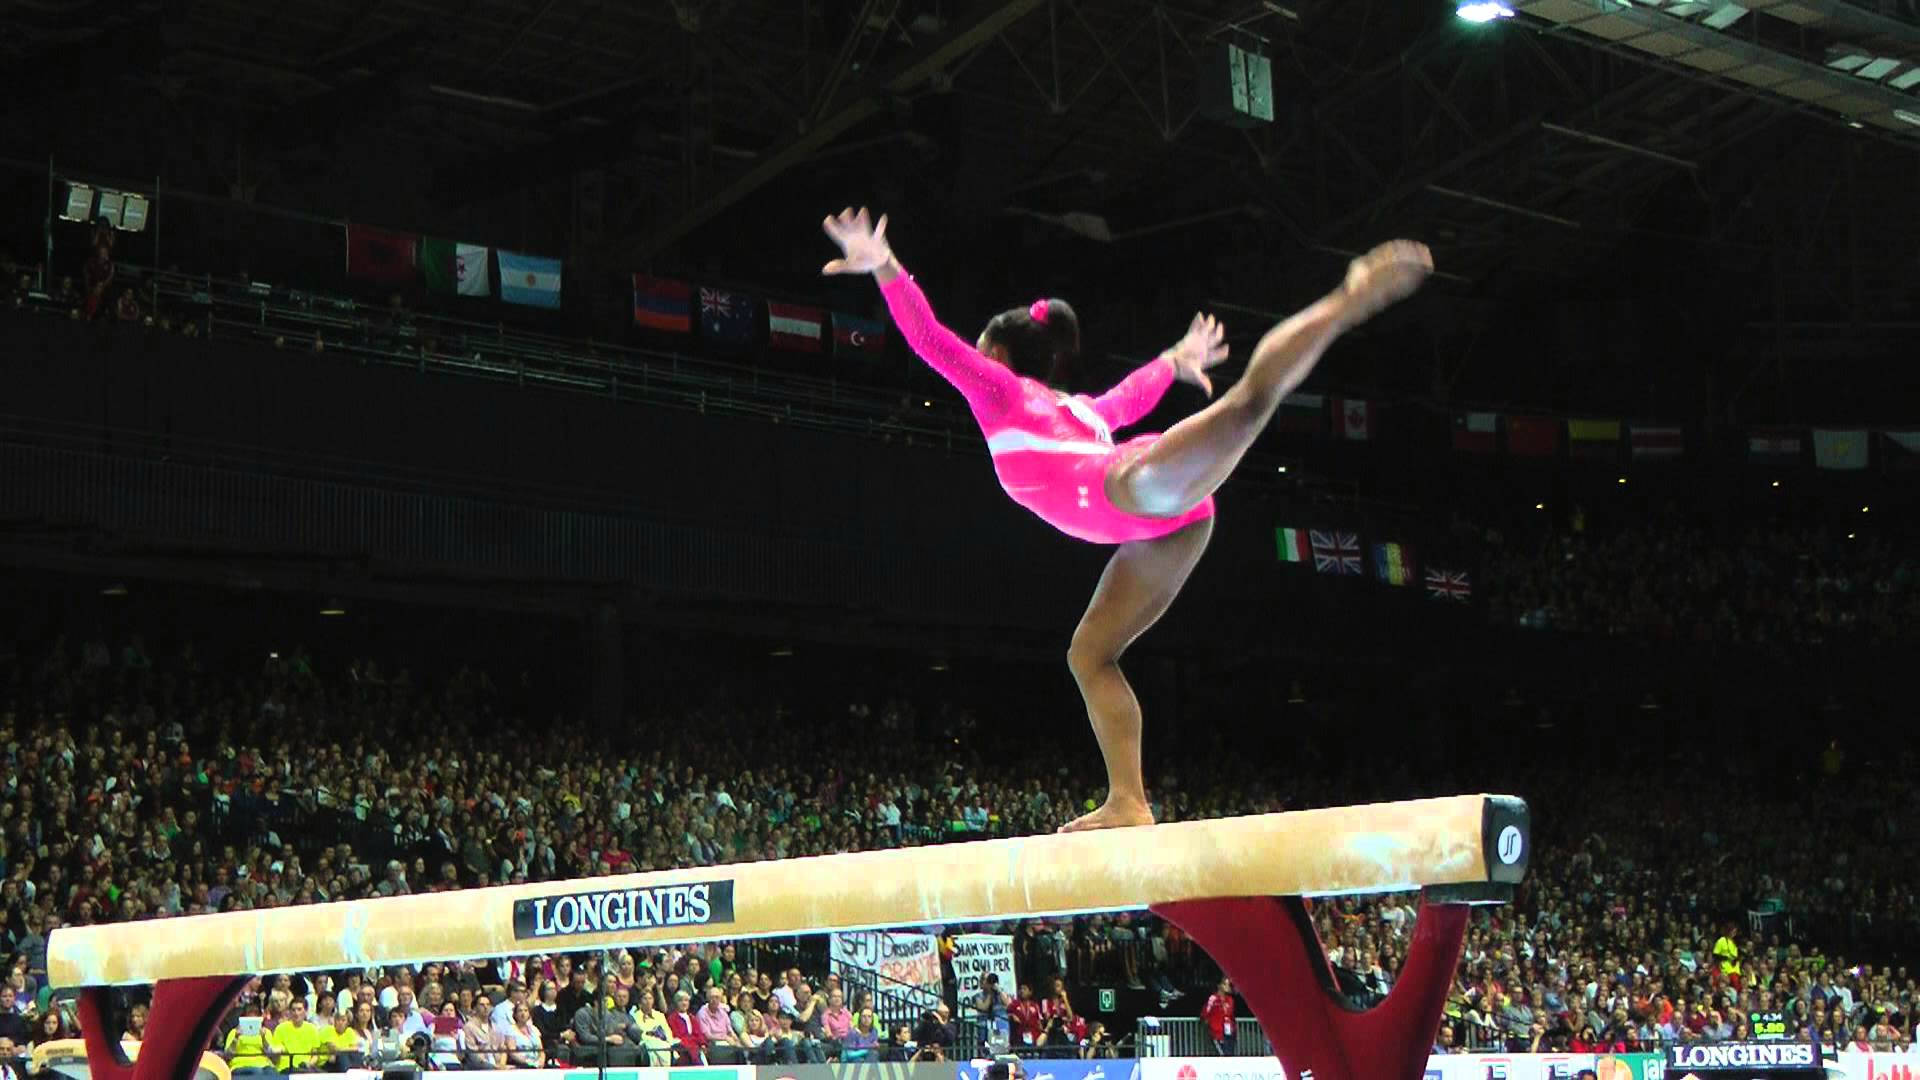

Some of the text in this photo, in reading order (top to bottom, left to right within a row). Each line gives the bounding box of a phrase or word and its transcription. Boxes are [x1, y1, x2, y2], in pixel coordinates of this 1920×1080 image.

[534, 886, 711, 935] LONGINES
[972, 959, 991, 972] QUI
[993, 957, 1010, 971] PER
[1673, 1045, 1813, 1067] LONGINES
